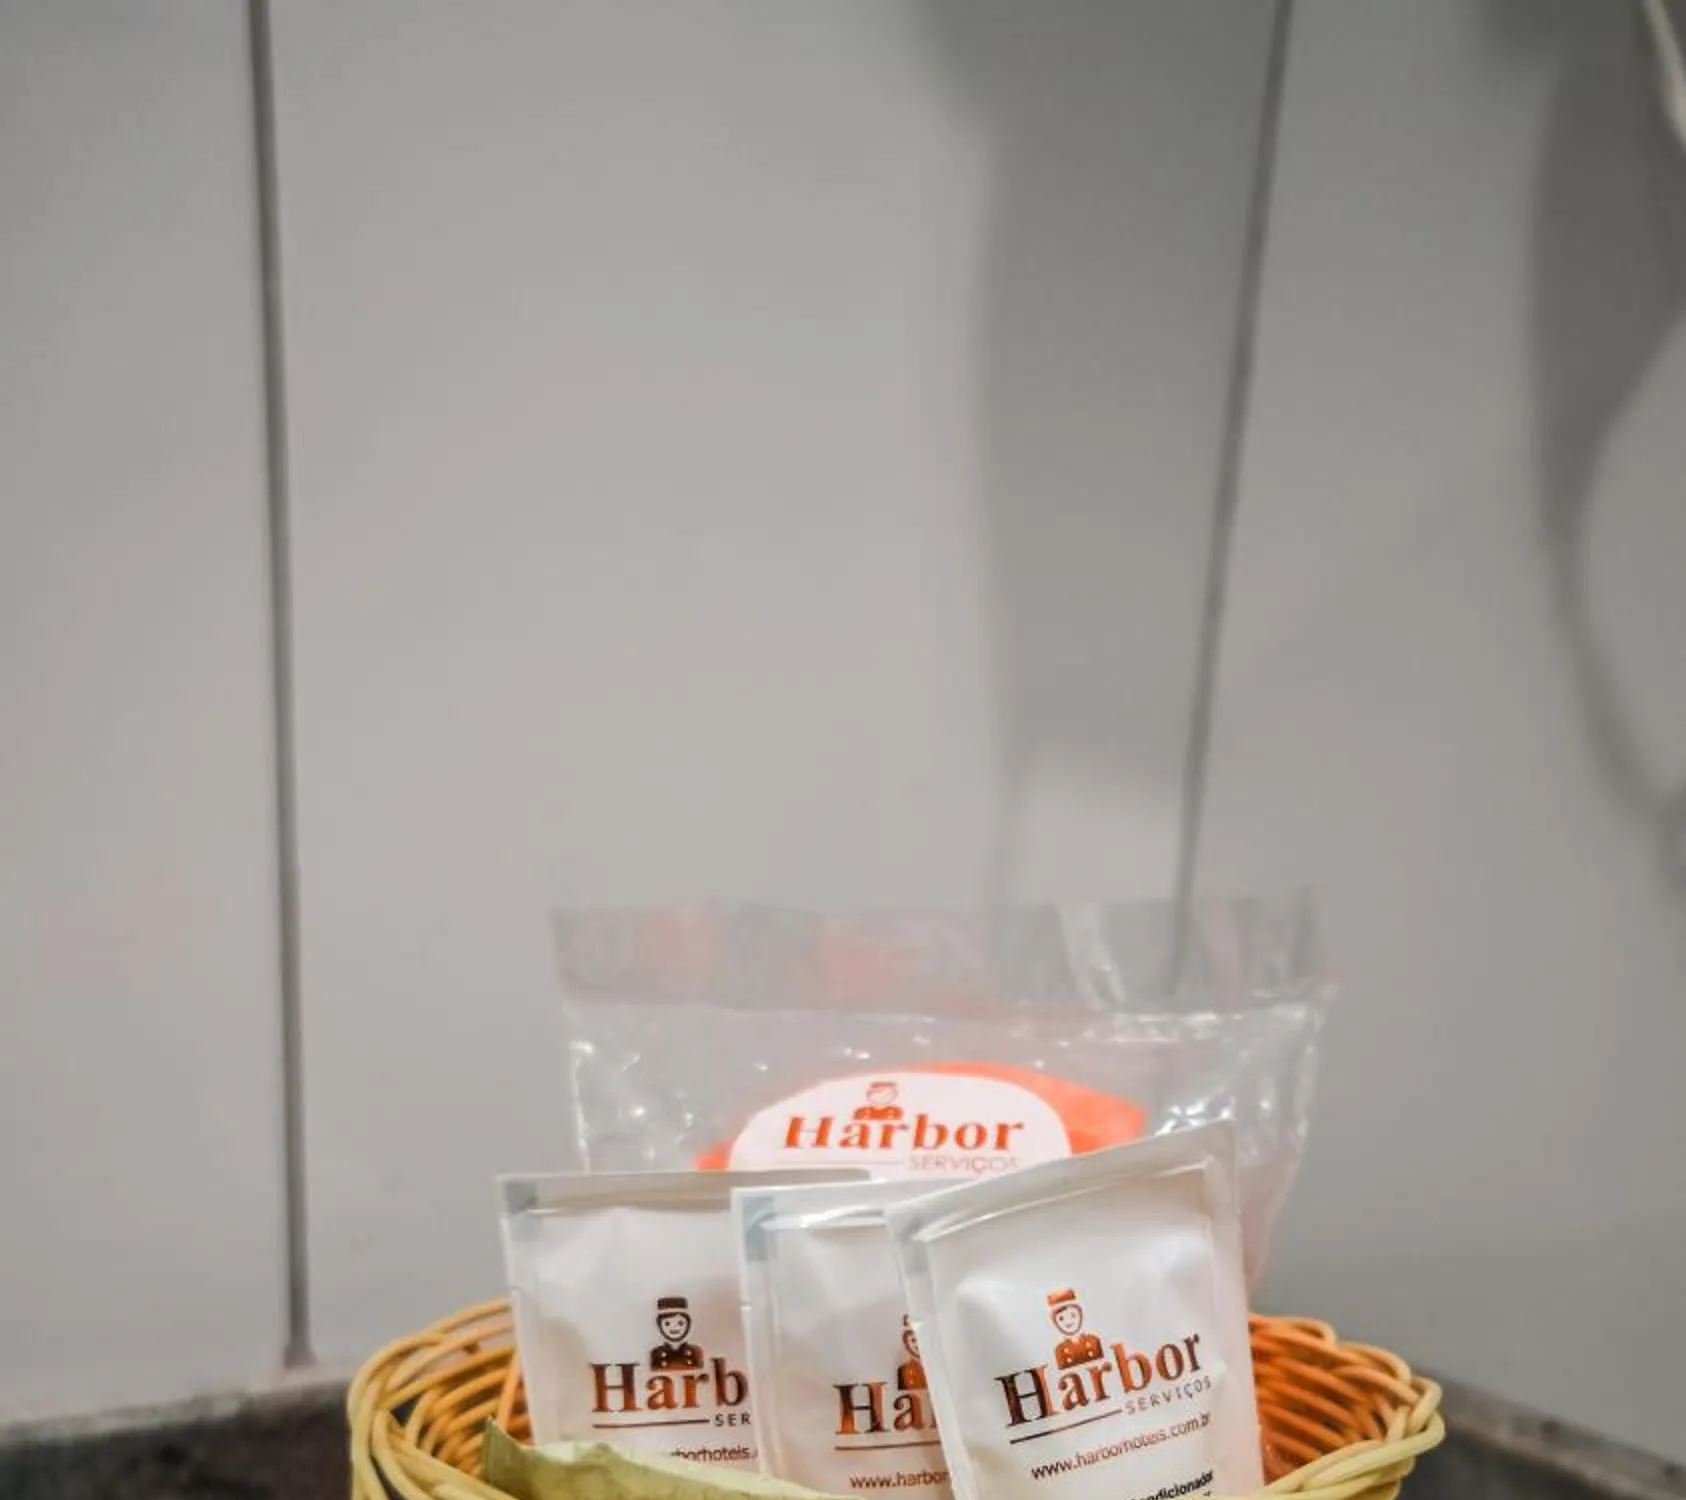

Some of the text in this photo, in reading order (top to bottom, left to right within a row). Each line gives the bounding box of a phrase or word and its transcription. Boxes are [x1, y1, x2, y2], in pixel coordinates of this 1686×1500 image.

[784, 1113, 1025, 1151] Harbor
[908, 1155, 1020, 1174] SERVIÇOS
[589, 1357, 748, 1413] Harb
[994, 1332, 1200, 1427] Harbor
[1125, 1375, 1212, 1415] SERVIÇOS
[832, 1381, 938, 1435] Ha
